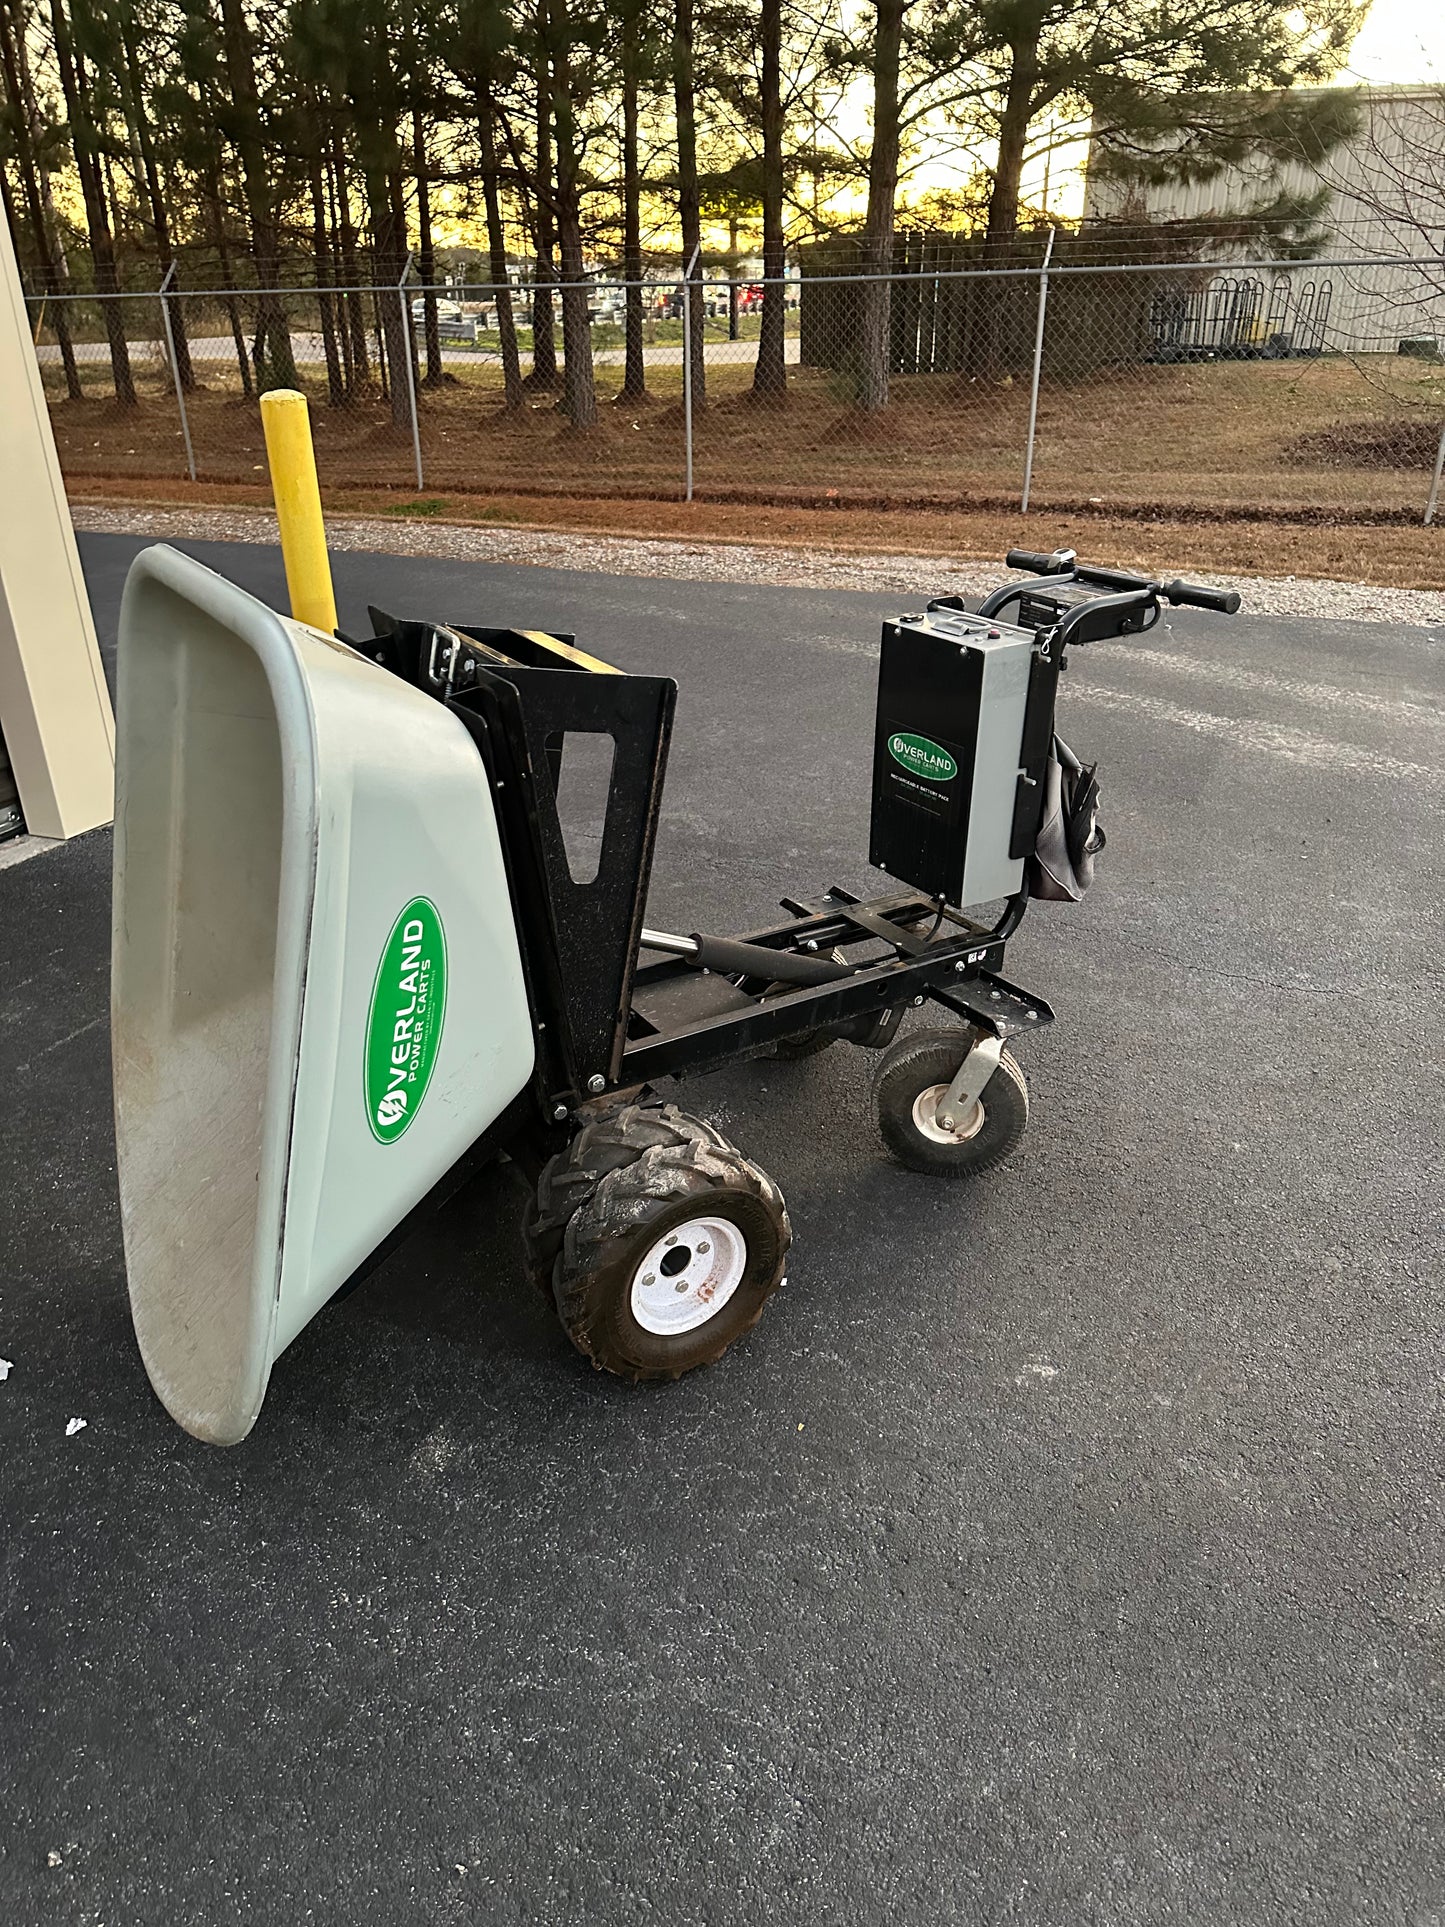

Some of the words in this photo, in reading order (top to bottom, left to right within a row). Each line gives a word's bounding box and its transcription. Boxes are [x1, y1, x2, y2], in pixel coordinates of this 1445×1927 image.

[893, 738, 952, 771] OVERLAND
[903, 754, 921, 764] POWER
[922, 762, 939, 772] CARTS
[416, 958, 431, 1015] CARTS
[377, 919, 424, 1127] OVERLAND
[408, 1021, 425, 1083] POWER
